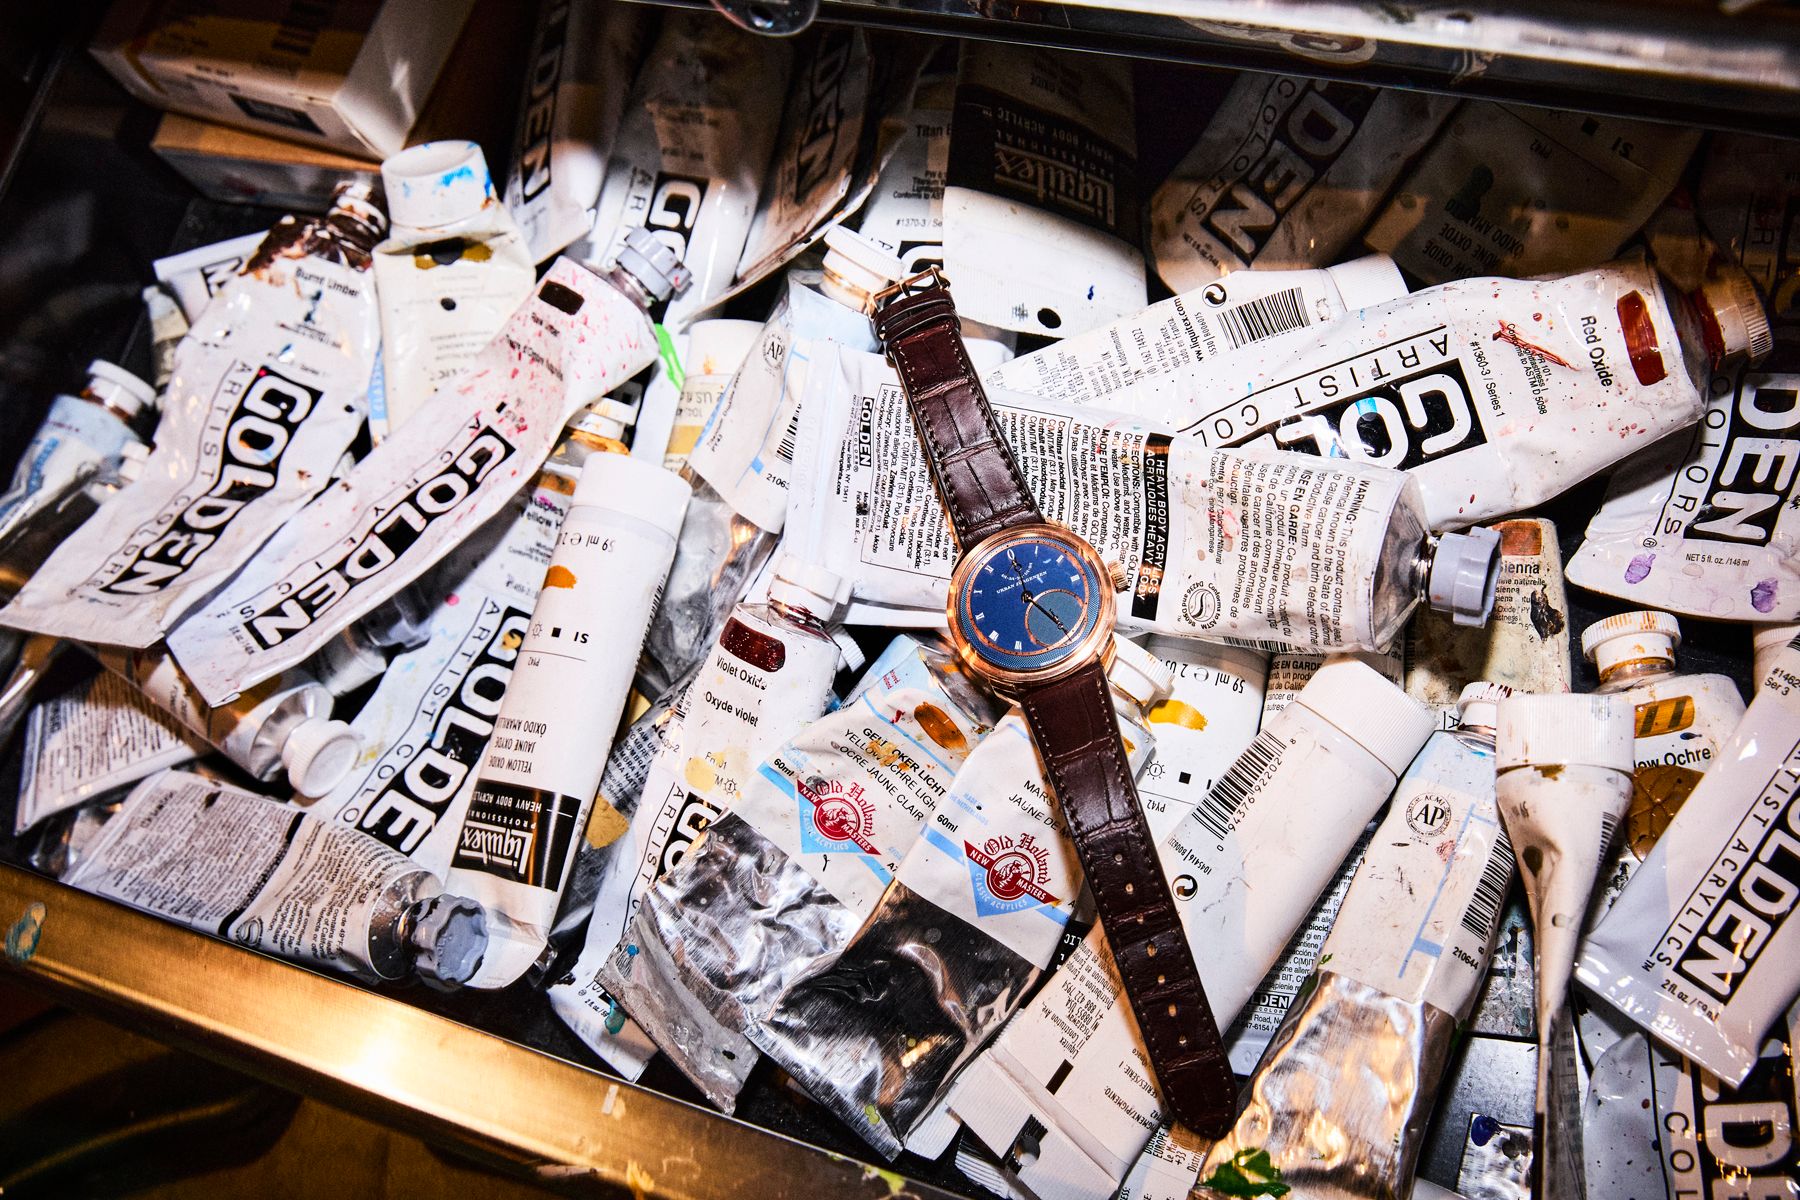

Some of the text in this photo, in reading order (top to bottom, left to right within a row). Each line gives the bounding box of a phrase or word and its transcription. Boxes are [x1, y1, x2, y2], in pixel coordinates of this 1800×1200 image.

[1294, 334, 1448, 409] ARTIST
[1580, 315, 1613, 388] Red Oxide
[1469, 341, 1502, 412] #1360-3 Series
[1524, 366, 1538, 388] ASTM
[860, 398, 874, 466] GOLDEN
[1100, 429, 1110, 457] MODE
[110, 374, 312, 594] GOLDEN
[1131, 434, 1143, 490] DIRECTIONS:
[1123, 500, 1131, 515] and
[1132, 492, 1141, 533] Compatible
[1137, 449, 1157, 600] ACRYLIQUES HEAVY BODY
[1147, 459, 1167, 594] HEAVY BODY ACRYLICS
[1265, 492, 1277, 537] Californie
[252, 434, 506, 646] GOLDEN
[1242, 495, 1262, 610] cancer des anomalies
[1262, 538, 1273, 574] comme
[1272, 504, 1286, 582] produit chimique
[1281, 487, 1306, 597] EN GARDE: Ce produit
[1307, 482, 1338, 619] cause cancer and birth defects
[1321, 476, 1356, 600] chemical known the State
[1332, 480, 1370, 626] WARNING: This product contains
[1685, 553, 1700, 562] NET
[1230, 606, 1239, 618] de
[1254, 575, 1267, 615] pouvant
[421, 600, 501, 723] ARTIST
[717, 656, 739, 678] Violet
[1215, 672, 1246, 694] 59 ml
[1764, 677, 1783, 694] Ser
[705, 691, 759, 728] Oxyde violet
[507, 759, 532, 774] YELLOW
[773, 758, 794, 778] 60ml
[1664, 747, 1711, 770] Ochre
[496, 794, 542, 813] HEAVY BODY
[839, 746, 867, 771] OCRE
[867, 766, 896, 795] JAUNE
[896, 794, 925, 822] CLAIR
[918, 769, 947, 798] LICHT
[1228, 757, 1283, 832] 94376 92202
[801, 787, 873, 853] NEW MASTERS
[849, 782, 877, 838] Holland
[936, 814, 959, 833] 60ml
[1008, 793, 1044, 823] JAUNE
[1414, 804, 1445, 828] AP
[460, 820, 534, 875] Liquitex
[983, 832, 1052, 886] Old Holland
[969, 851, 1048, 901] NEW MASTERS
[1657, 838, 1750, 966] ACRYLICS
[1452, 946, 1479, 970] 210644
[1059, 1037, 1079, 1060] Liquitex
[1152, 1131, 1169, 1160] EUROPE
[1174, 1151, 1187, 1166] +33
